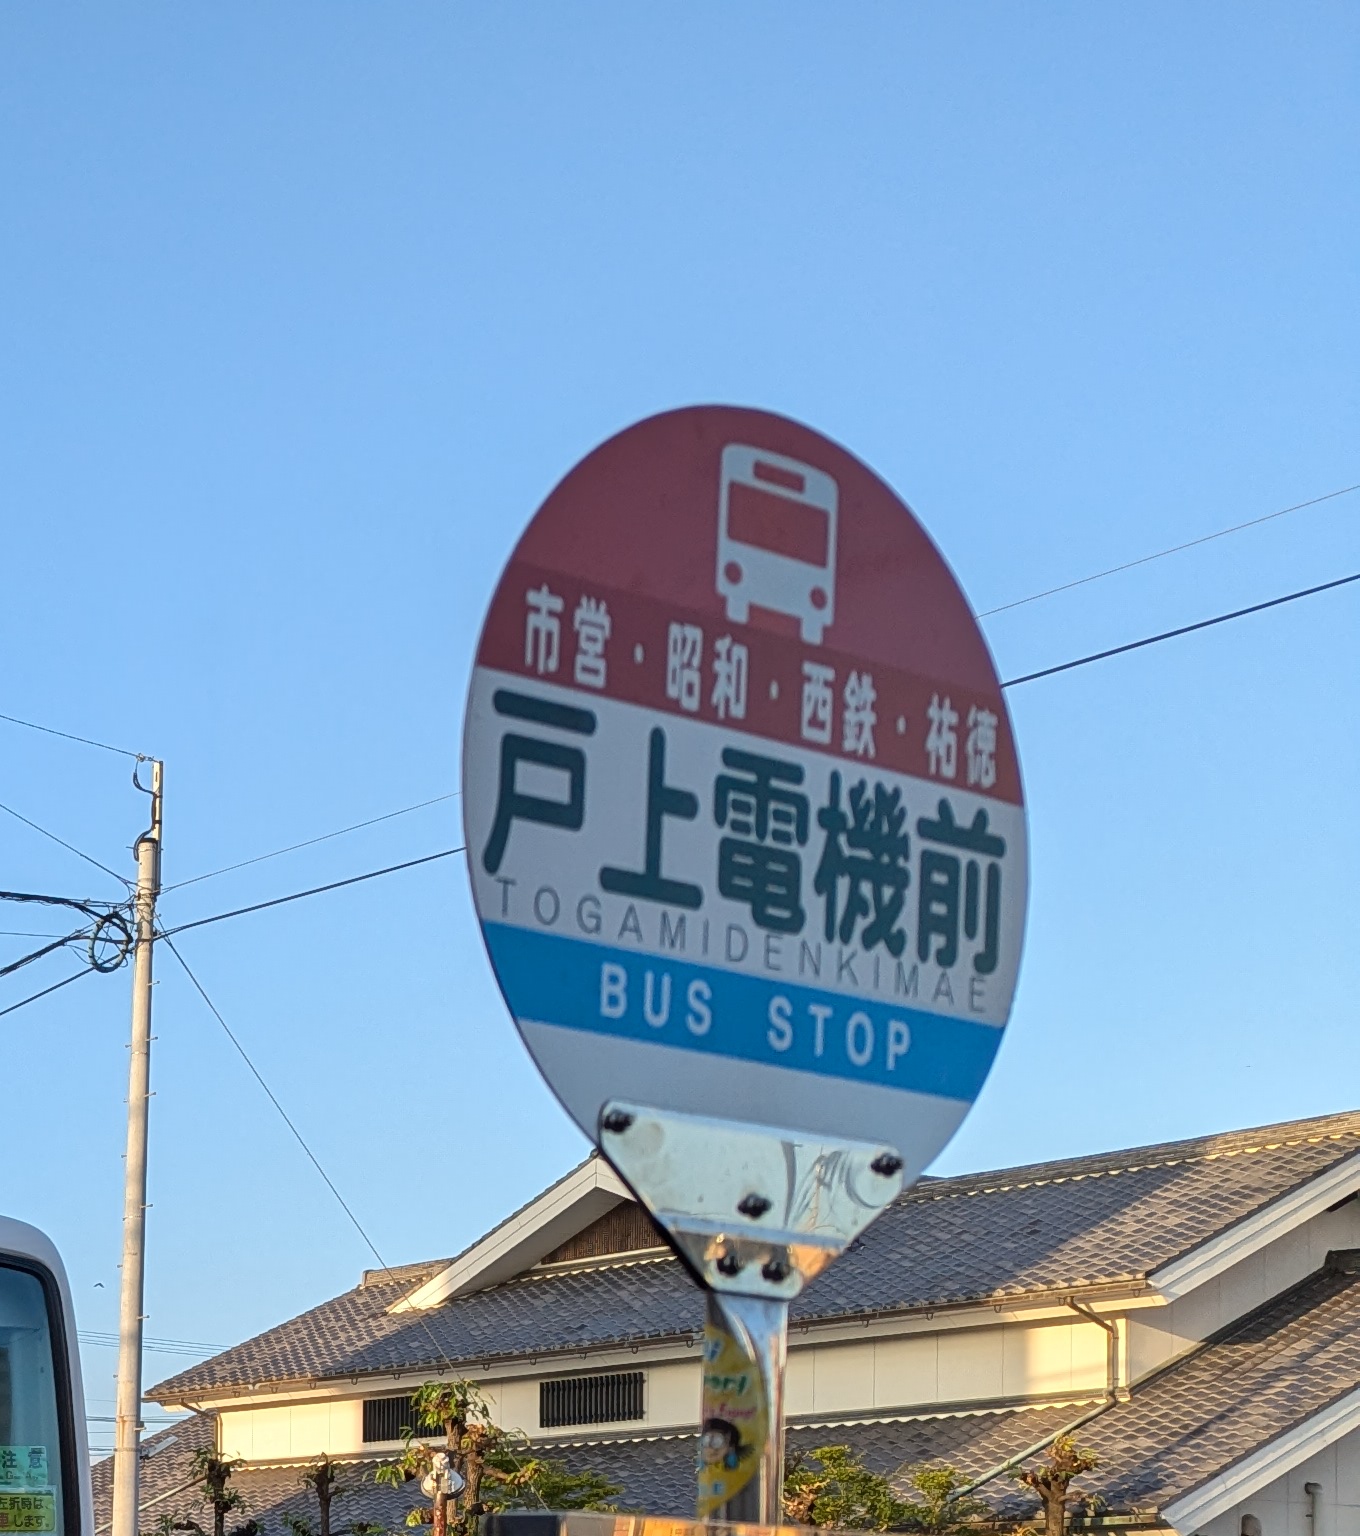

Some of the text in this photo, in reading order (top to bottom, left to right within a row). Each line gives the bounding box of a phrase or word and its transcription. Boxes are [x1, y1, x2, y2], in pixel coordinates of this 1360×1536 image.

[482, 687, 1008, 976] 戸上電機前
[495, 877, 990, 1014] TOGAMIDENKIMAE
[600, 963, 913, 1071] BUS STOP
